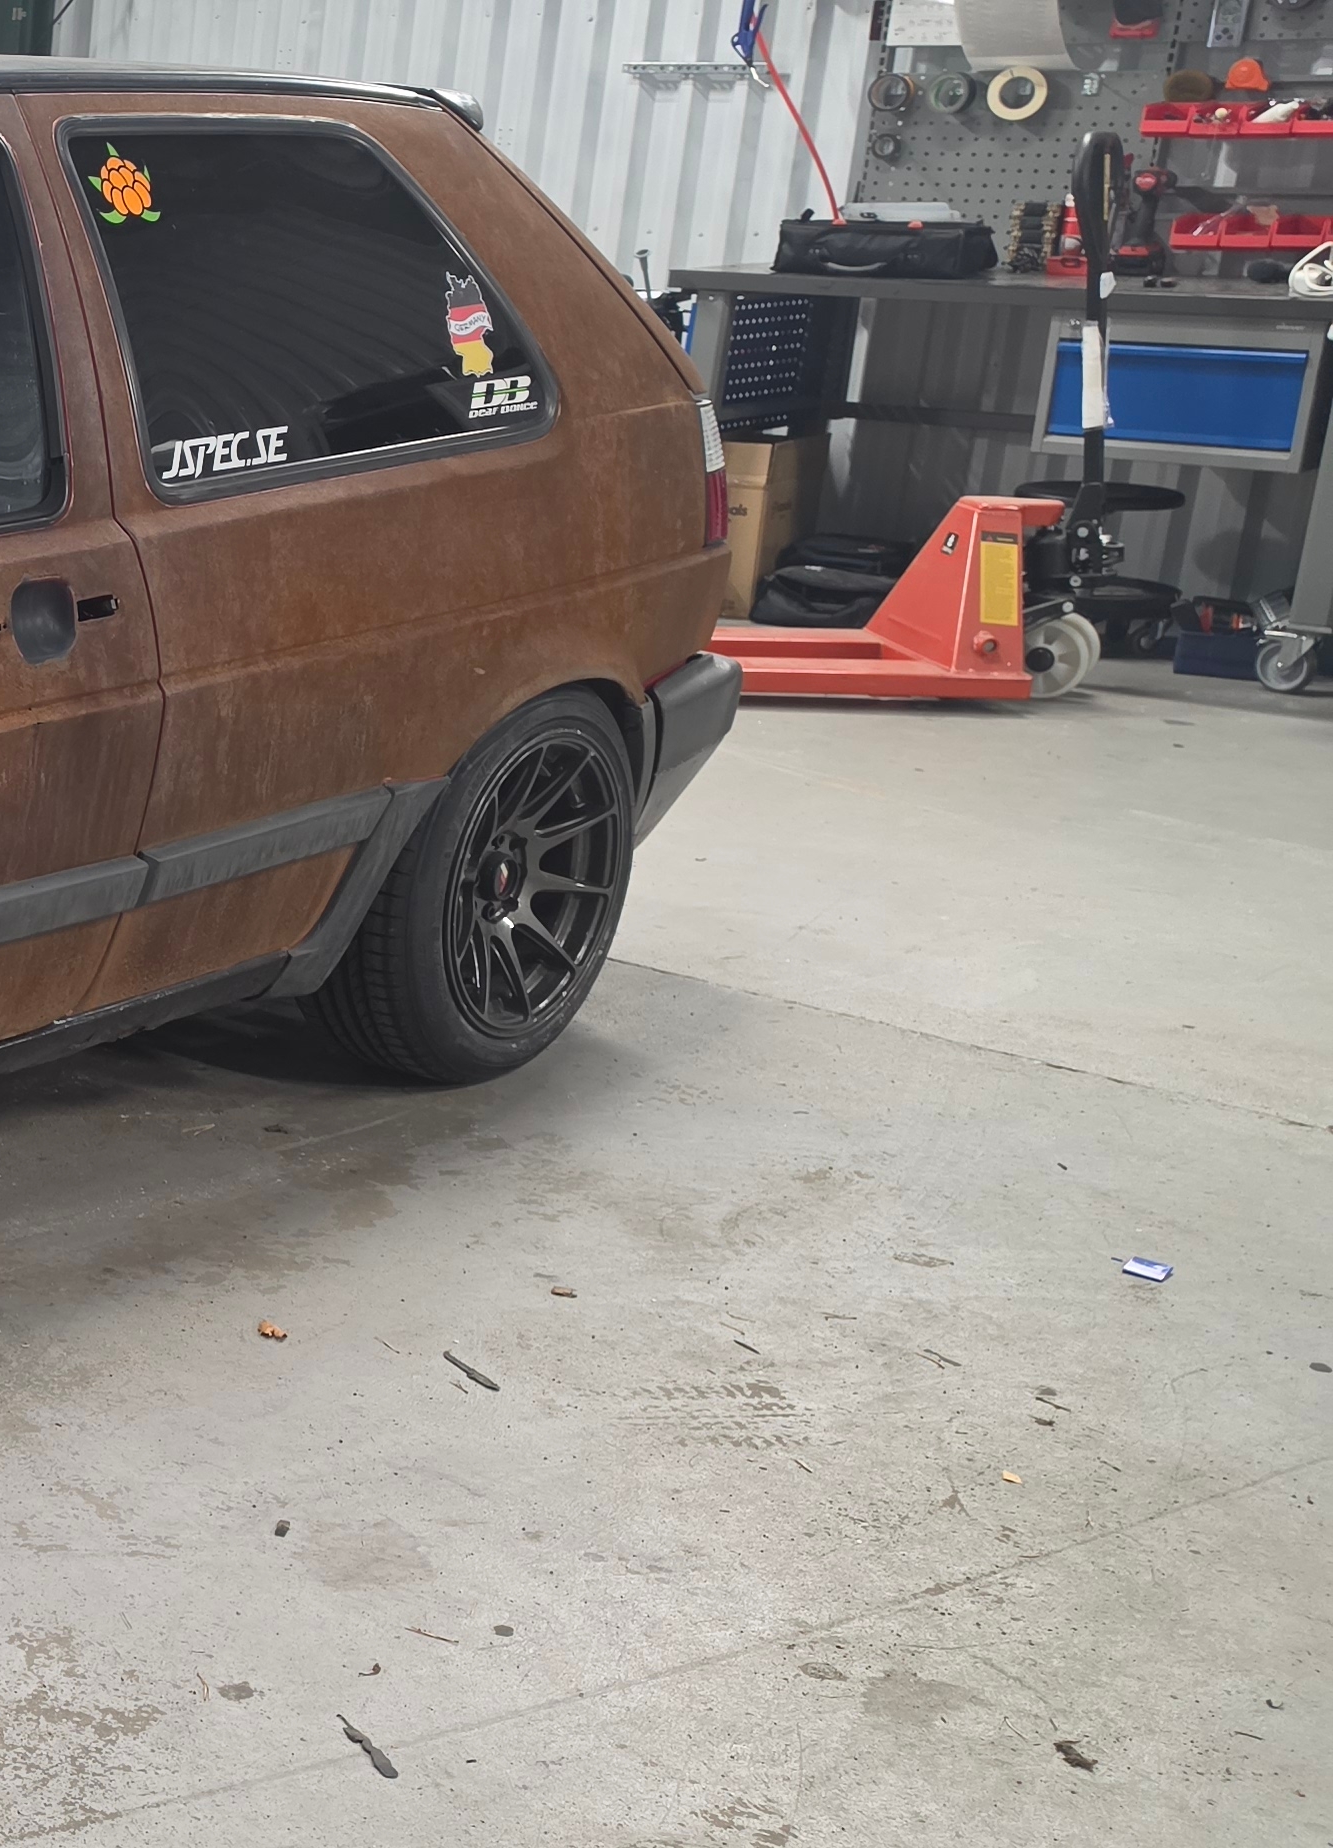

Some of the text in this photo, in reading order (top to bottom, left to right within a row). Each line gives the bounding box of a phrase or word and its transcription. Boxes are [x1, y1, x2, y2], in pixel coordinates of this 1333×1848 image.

[454, 314, 487, 331] GERMANY
[471, 375, 532, 409] DB
[162, 425, 289, 479] JSPEC.SE
